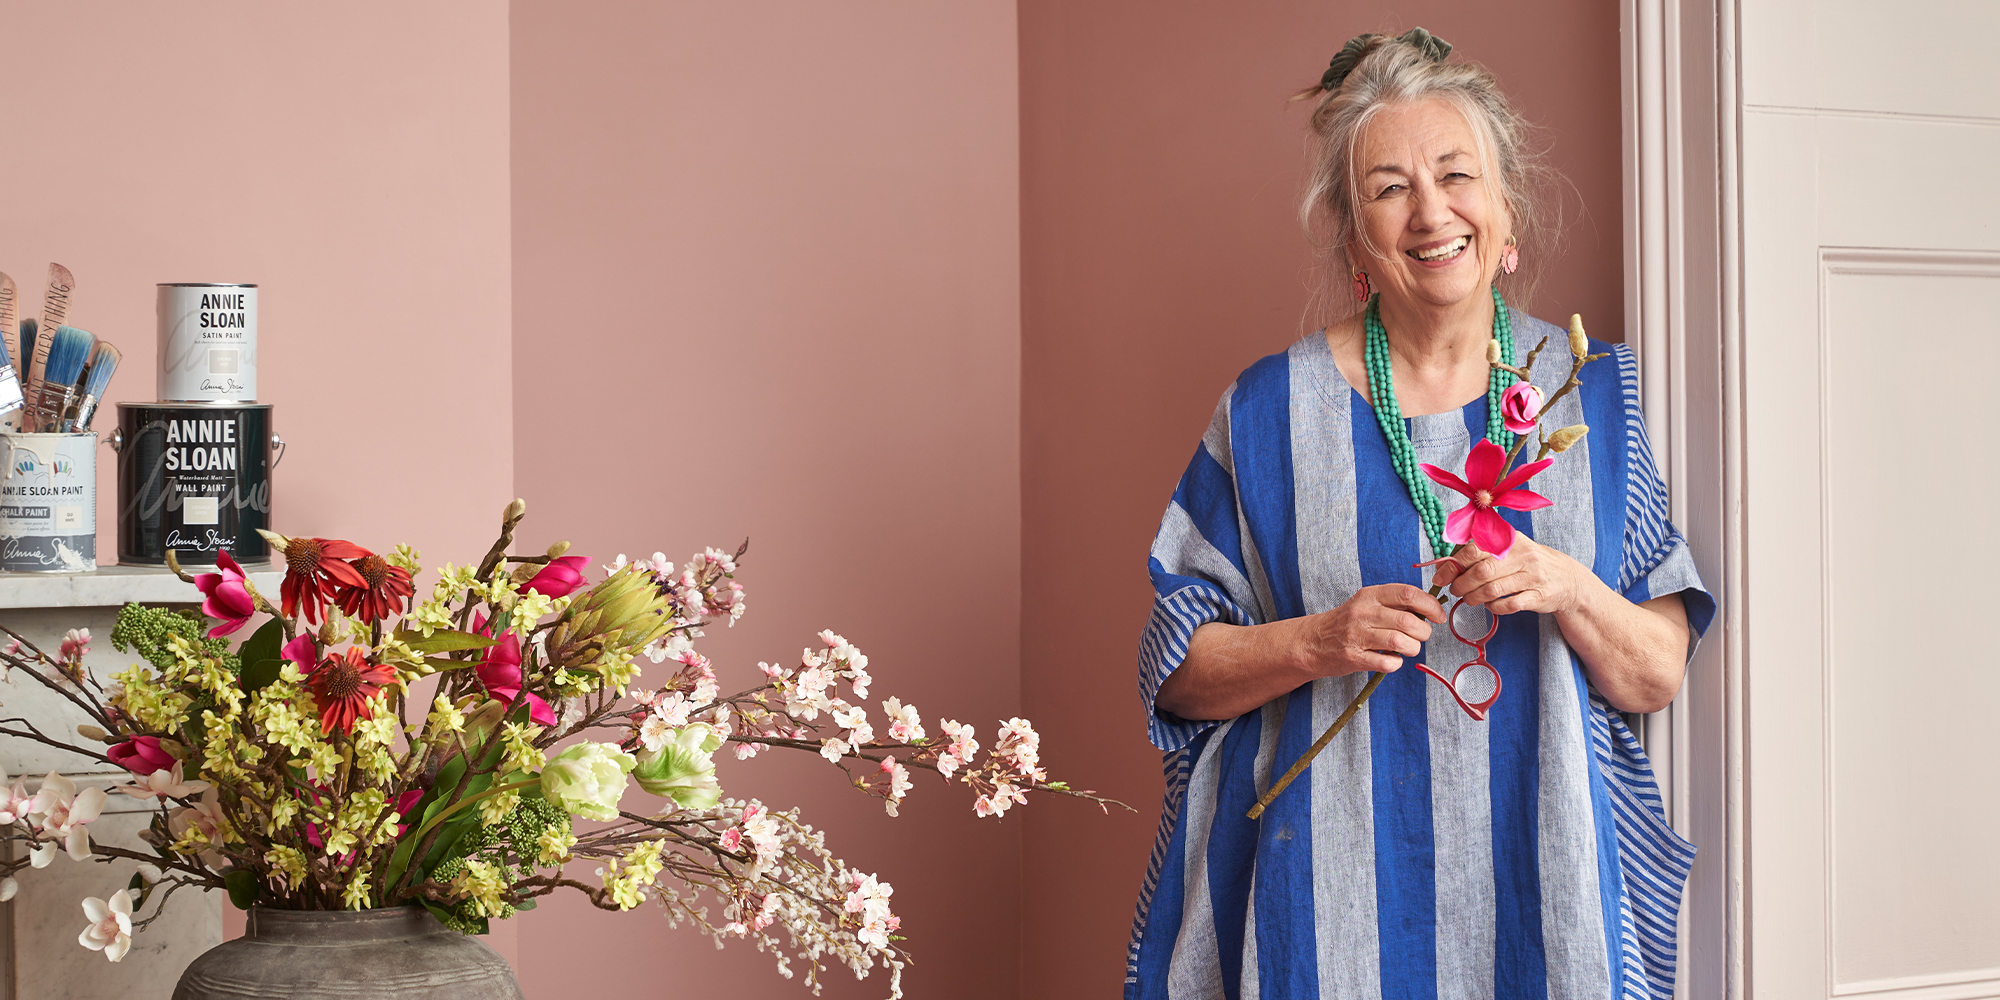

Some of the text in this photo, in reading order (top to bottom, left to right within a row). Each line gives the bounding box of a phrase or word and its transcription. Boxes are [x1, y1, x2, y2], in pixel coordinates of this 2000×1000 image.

[200, 293, 245, 310] ANNIE
[36, 282, 70, 366] EVERYTHING
[200, 312, 245, 328] SLOAN
[166, 419, 236, 443] ANNIE
[165, 446, 236, 471] SLOAN
[61, 485, 84, 496] PAINT
[175, 484, 227, 492] WALL PAINT
[25, 508, 48, 517] PAINT
[165, 529, 203, 547] Annie
[3, 539, 45, 560] Annie
